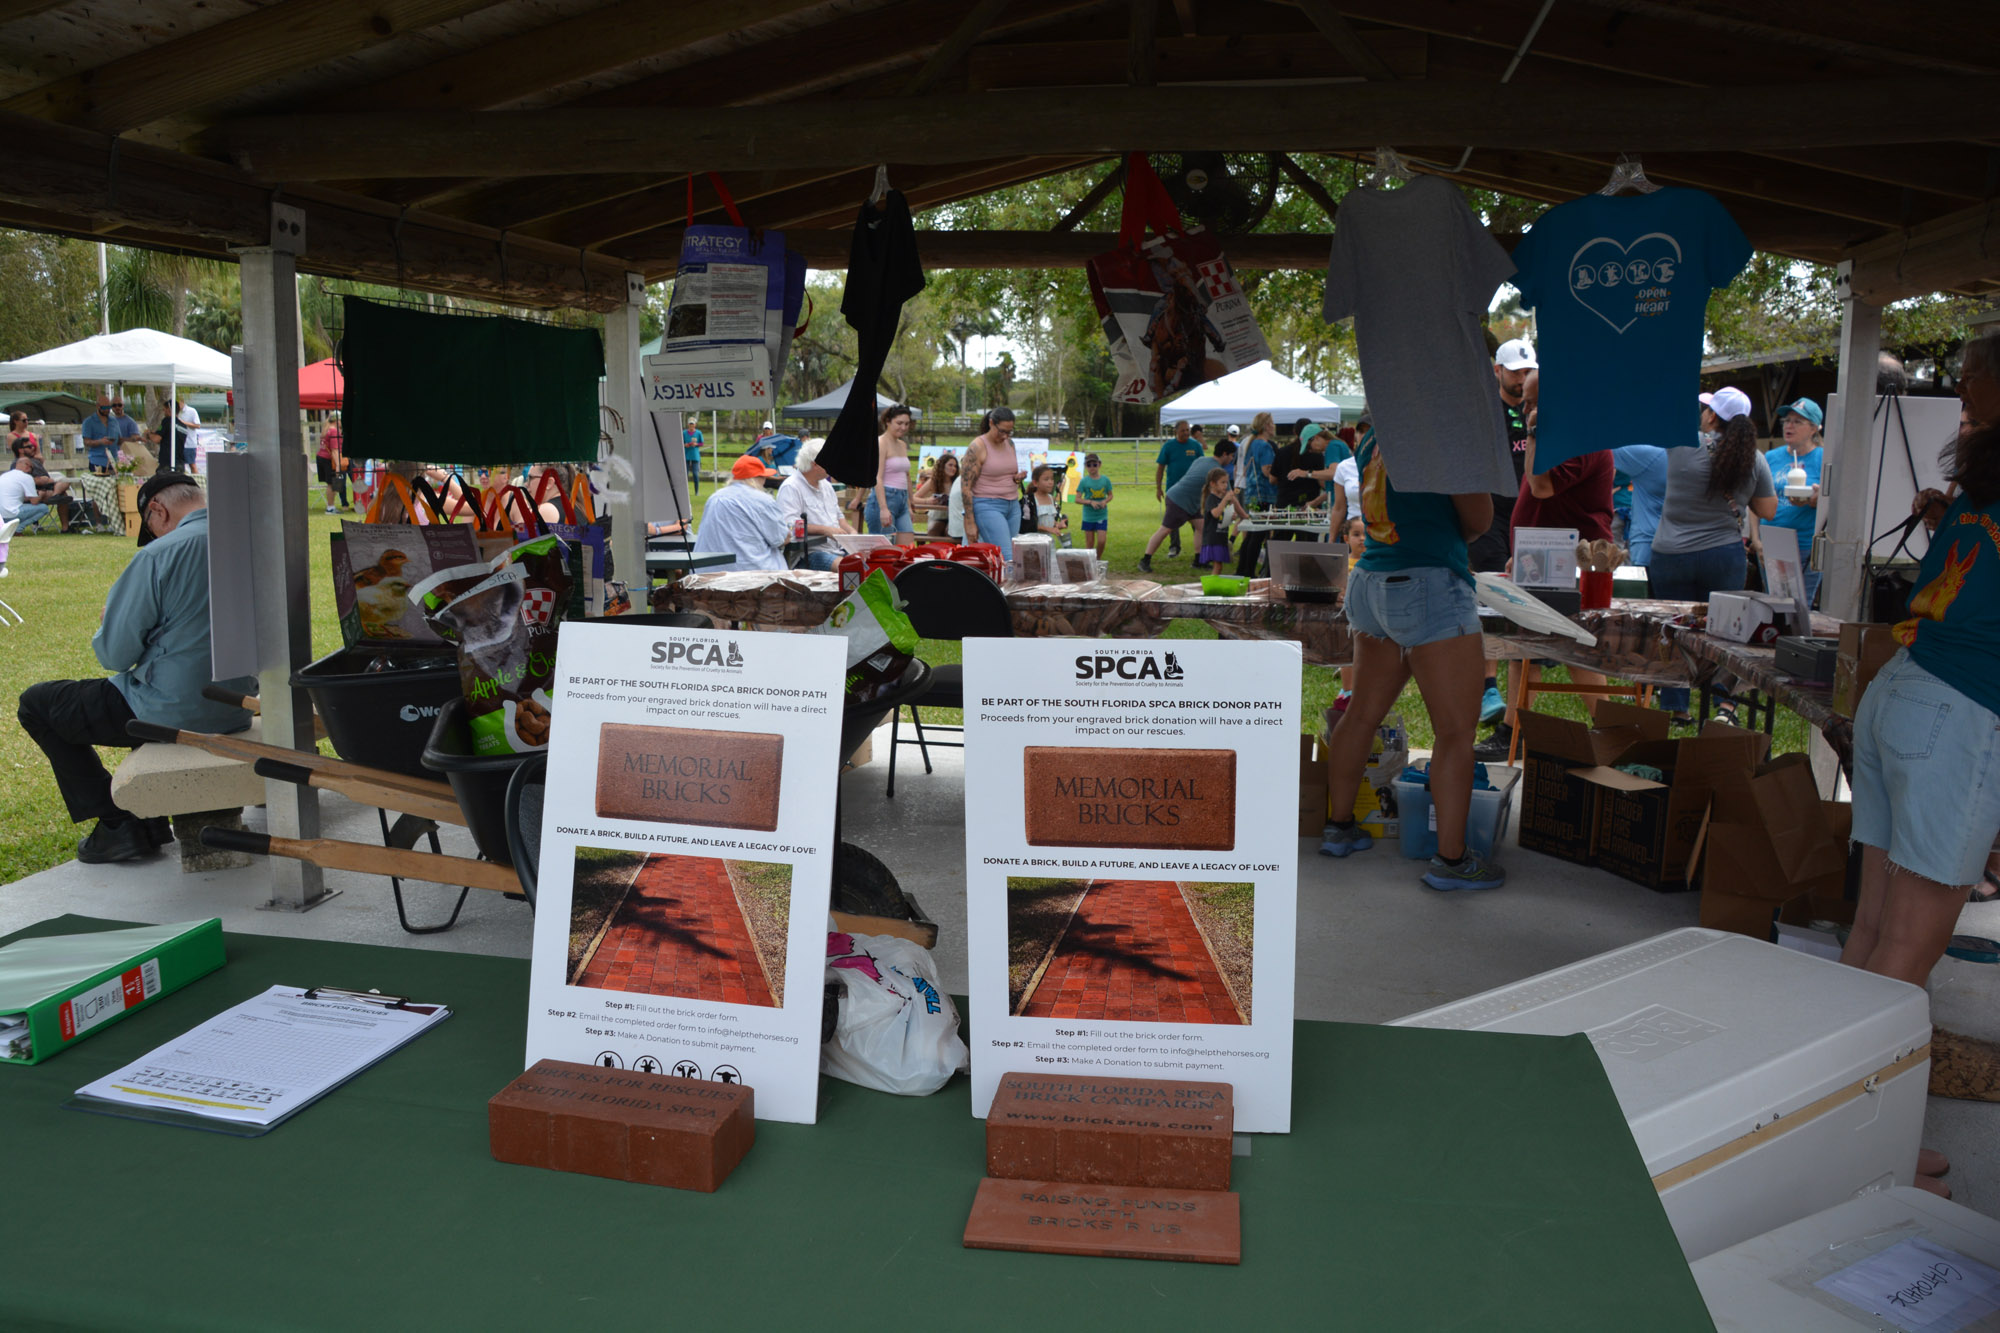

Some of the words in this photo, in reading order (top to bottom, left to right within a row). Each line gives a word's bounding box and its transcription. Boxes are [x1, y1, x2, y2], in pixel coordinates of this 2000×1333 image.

[653, 381, 735, 400] STRATEGY
[548, 524, 576, 533] ATEGY
[651, 641, 724, 666] SPCA
[1075, 656, 1162, 680] SPCA
[470, 671, 513, 702] Apple
[569, 676, 580, 684] BE
[582, 677, 605, 685] PART
[606, 678, 618, 686] OF
[620, 679, 637, 687] THE
[639, 680, 669, 689] SOUTH
[670, 682, 709, 691] FLORIDA
[711, 685, 734, 693] SPCA
[736, 686, 764, 695] BRICK
[766, 688, 800, 697] DONOR
[802, 690, 827, 699] PATH
[567, 690, 604, 700] Proceeds
[606, 692, 625, 701] from
[646, 697, 687, 706] engraved
[689, 698, 710, 707] brick
[712, 699, 751, 709] donation
[753, 702, 769, 710] will
[771, 703, 792, 712] have
[801, 705, 827, 714] direct
[646, 705, 675, 715] impact
[707, 711, 740, 719] rescues.
[981, 698, 994, 706] BE
[997, 698, 1024, 706] PART
[1041, 699, 1062, 707] THE
[1064, 699, 1099, 707] SOUTH
[1102, 699, 1146, 708] FLORIDA
[1149, 700, 1176, 708] SPCA
[1178, 700, 1210, 708] BRICK
[1213, 701, 1251, 709] DONOR
[1254, 701, 1281, 709] PATH
[981, 713, 1024, 722] Proceeds
[1027, 714, 1050, 722] from
[1052, 716, 1074, 724] your
[1076, 715, 1121, 725] engraved
[1125, 715, 1149, 724] brick
[1152, 716, 1196, 725] donation
[1199, 716, 1216, 725] will
[1219, 717, 1243, 725] have
[1254, 717, 1283, 725] direct
[1075, 725, 1110, 736] impact
[623, 752, 753, 781] MEMORIAL
[642, 780, 731, 805] BRICKS
[1055, 777, 1203, 800] MEMORIAL
[1537, 779, 1568, 802] ORDER
[1079, 804, 1180, 826] BRICKS
[1615, 799, 1644, 824] ORDER
[1535, 815, 1574, 841] ARRIVED
[1612, 835, 1648, 864] ARRIVED
[983, 857, 1020, 865] DONATE
[1031, 859, 1060, 867] BRICK,
[1062, 859, 1088, 867] BUILD
[1099, 860, 1136, 869] FUTURE,
[351, 1007, 389, 1016] RESCUES
[1055, 1029, 1075, 1037] Step
[1182, 1033, 1203, 1041] form.
[992, 1040, 1011, 1048] Step
[1027, 1041, 1050, 1049] Email
[1067, 1044, 1112, 1052] completed
[1171, 1047, 1269, 1059] info@helpthehorses.org
[1035, 1055, 1054, 1064] Step
[1104, 1058, 1141, 1066] Donation
[536, 1066, 601, 1084] BRICKS
[606, 1076, 643, 1090] FOR
[648, 1082, 737, 1101] RESCUES
[1005, 1080, 1073, 1093] SOUTH
[1080, 1083, 1167, 1098] FLORIDA
[1174, 1087, 1225, 1101] SPCA
[513, 1081, 576, 1100] SOUTH
[580, 1092, 663, 1111] FLORIDA
[667, 1103, 718, 1119] SPCA
[1015, 1091, 1082, 1104] BRICK
[1090, 1095, 1216, 1111] CAMPAIGN
[1006, 1111, 1214, 1132] www.bricksrus.com
[1020, 1193, 1112, 1208] RAISING
[1120, 1199, 1197, 1212] FUNDS
[1081, 1208, 1135, 1220] WITH
[1028, 1216, 1114, 1231] BRICKS
[1125, 1222, 1140, 1232] R
[1151, 1223, 1183, 1235] US
[1886, 1262, 1963, 1308] GATORADE
